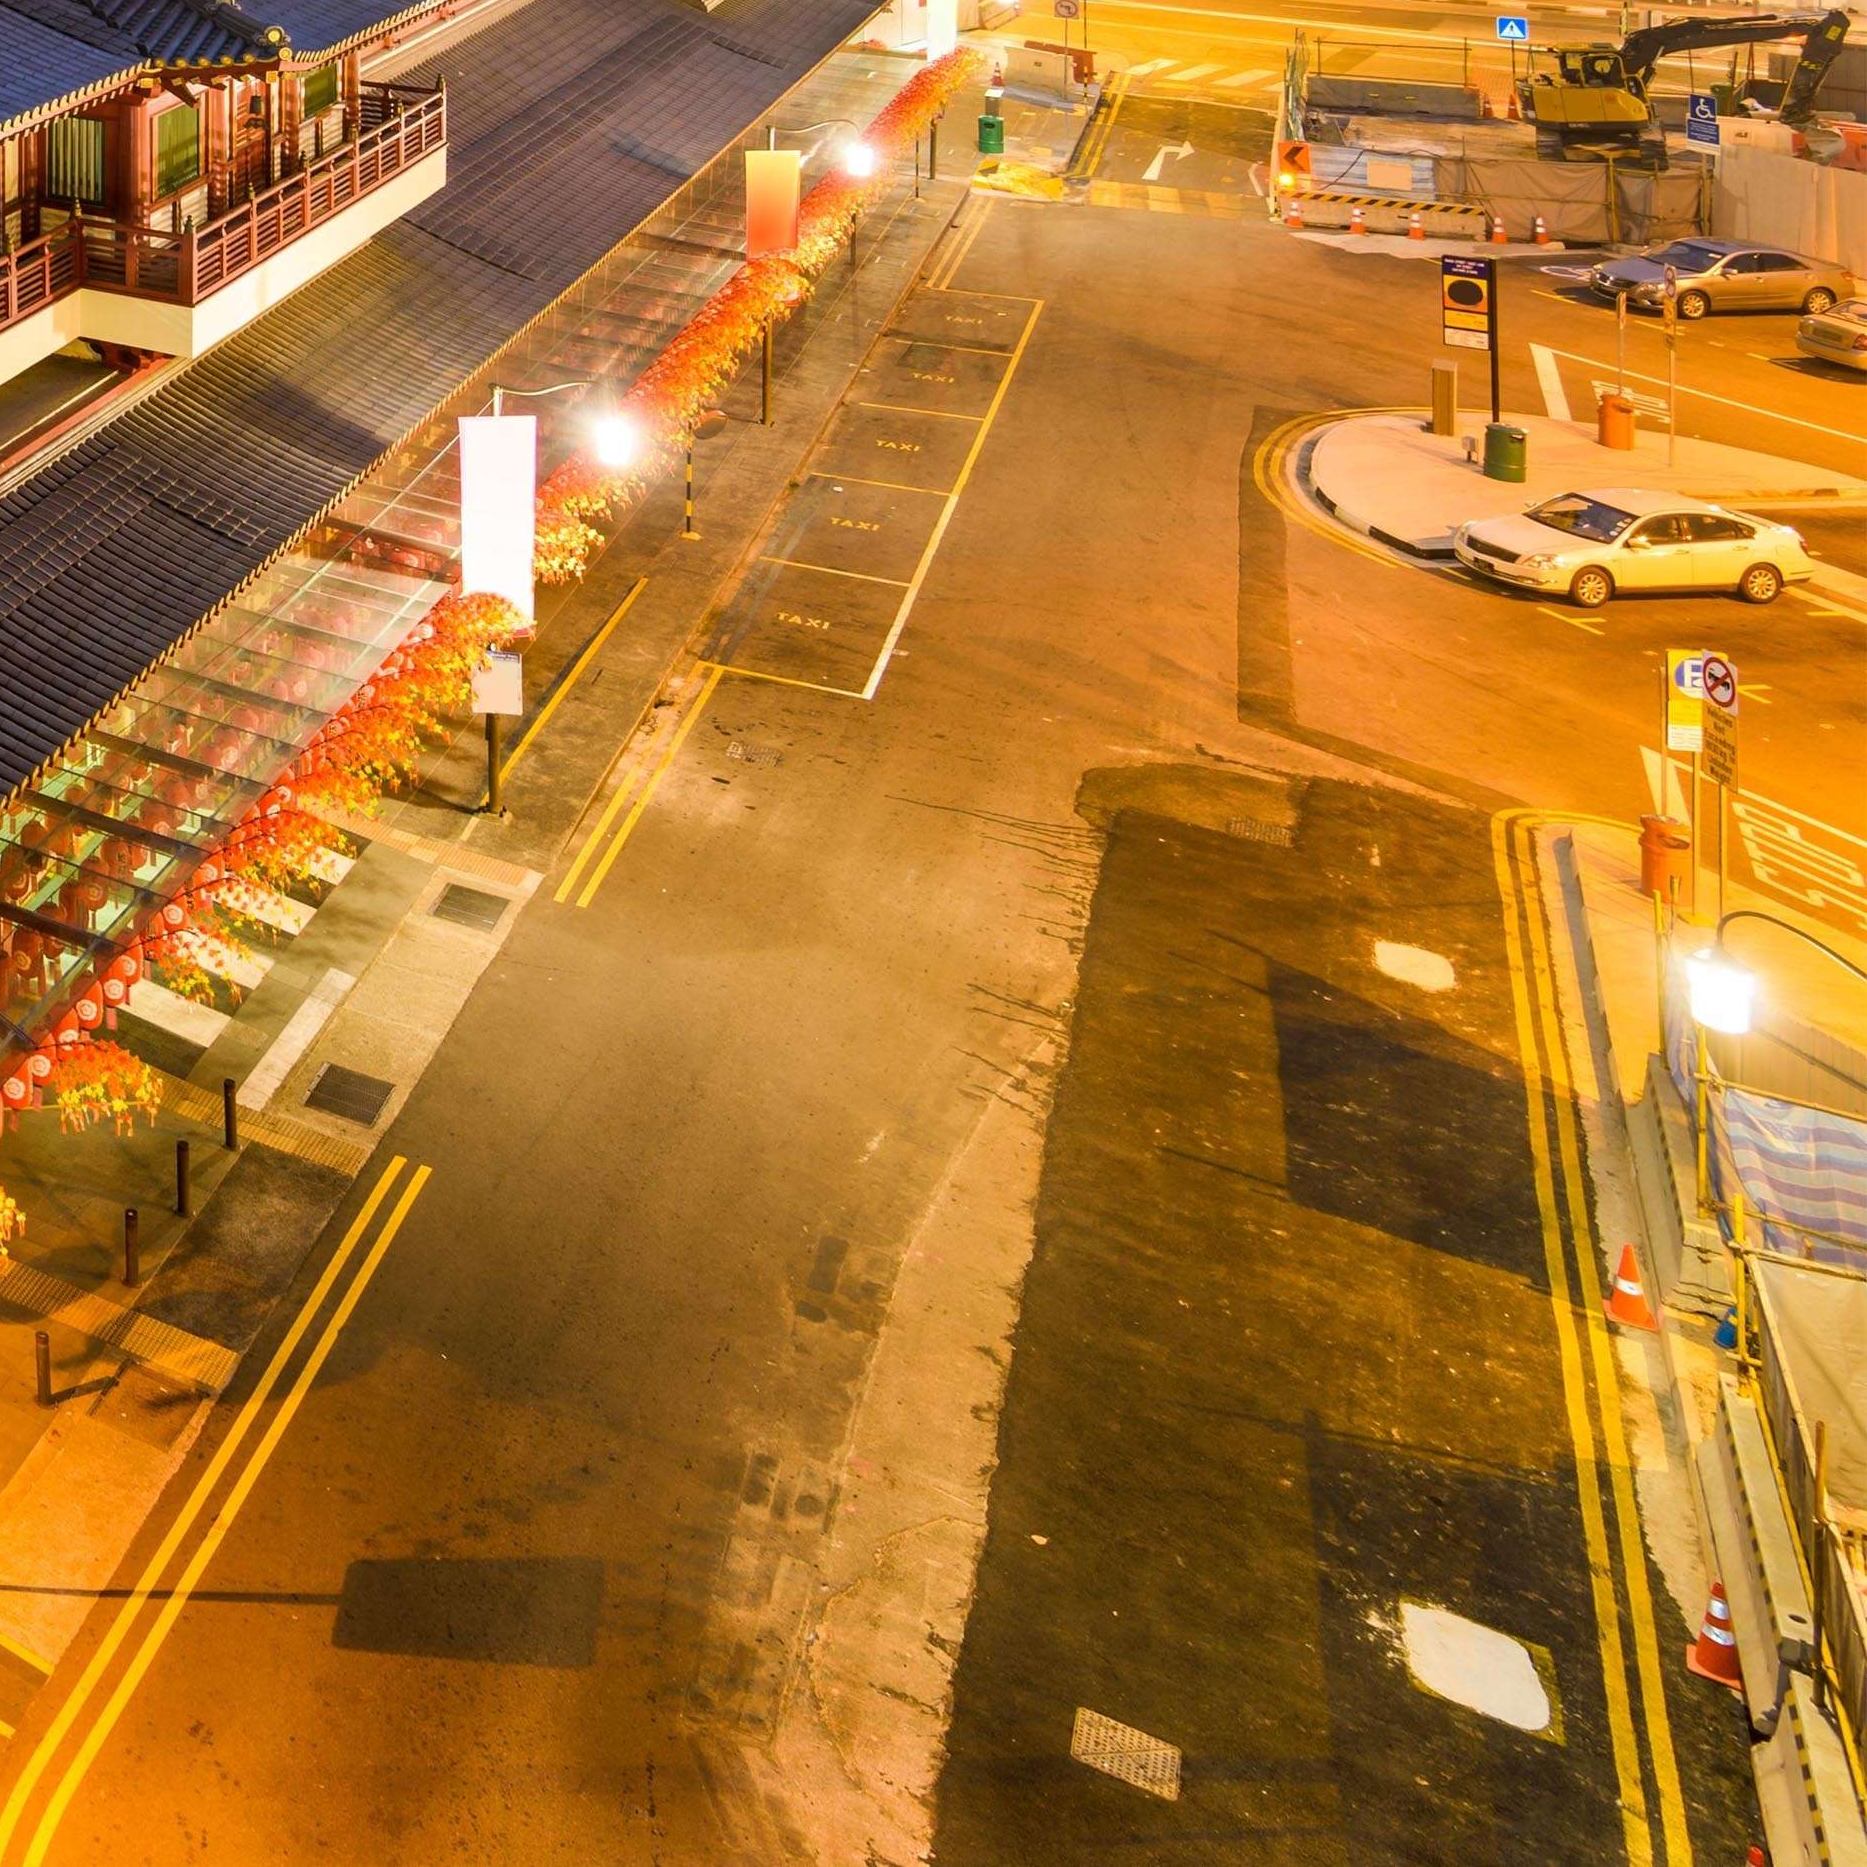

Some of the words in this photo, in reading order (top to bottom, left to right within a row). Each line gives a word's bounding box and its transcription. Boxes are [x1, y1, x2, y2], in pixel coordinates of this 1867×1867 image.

[912, 372, 955, 383] TAXI
[875, 439, 921, 452] TAXI
[830, 517, 880, 532] TAXI
[777, 612, 831, 630] TAXI
